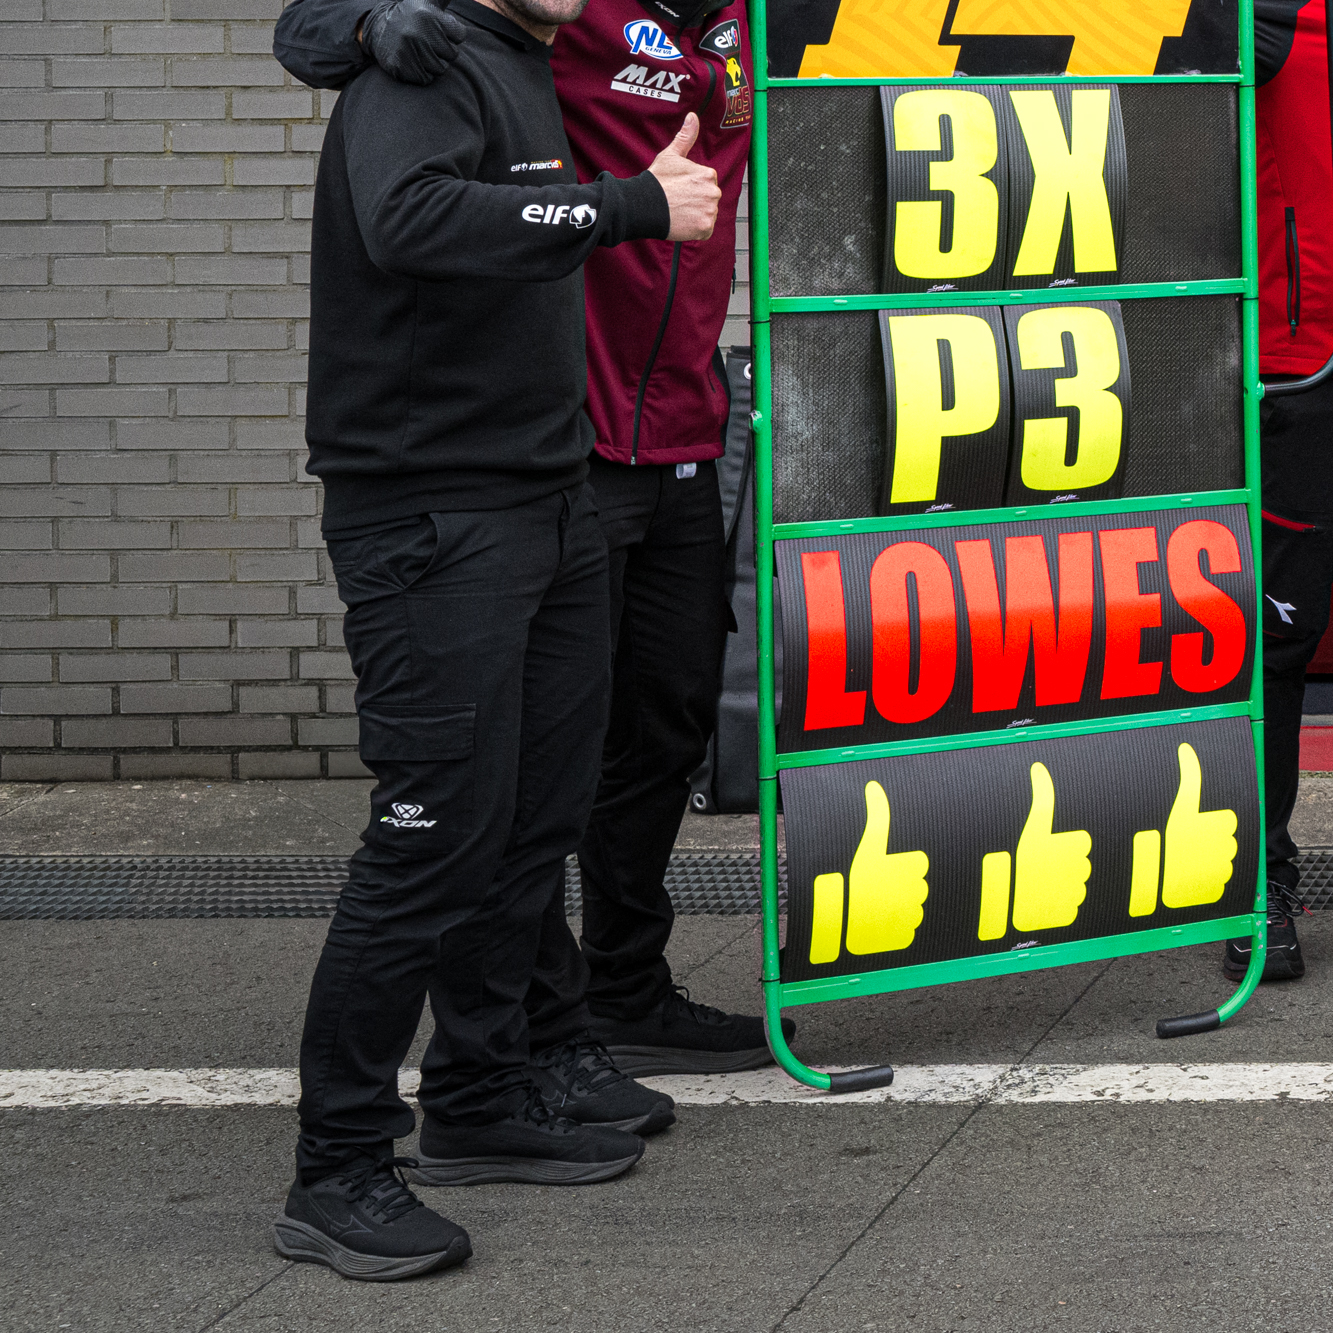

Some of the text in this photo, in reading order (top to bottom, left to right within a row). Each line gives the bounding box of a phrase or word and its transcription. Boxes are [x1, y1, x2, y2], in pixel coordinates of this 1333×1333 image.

[613, 63, 686, 94] MAX
[628, 85, 663, 98] CASES
[521, 203, 570, 225] elf
[893, 89, 1118, 279] 3X
[888, 306, 1123, 504] P3
[801, 520, 1247, 732] LOWES
